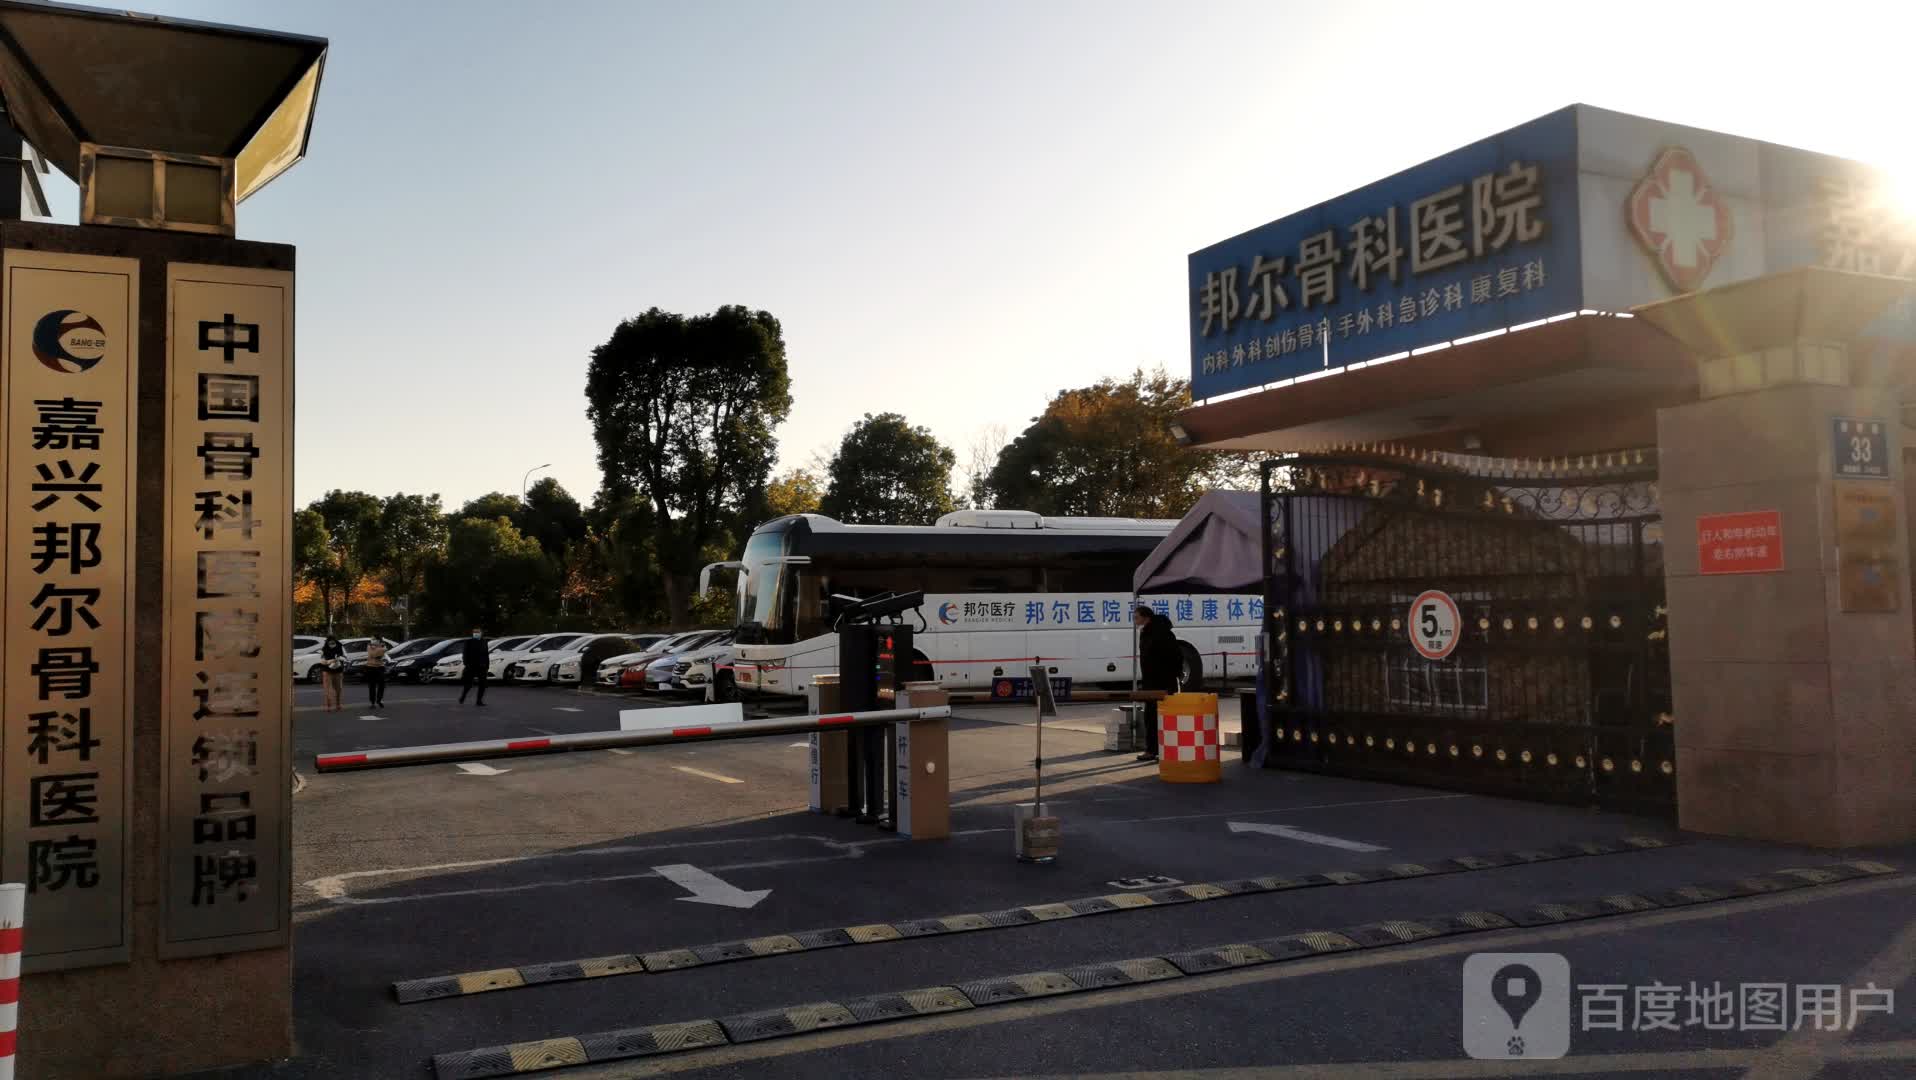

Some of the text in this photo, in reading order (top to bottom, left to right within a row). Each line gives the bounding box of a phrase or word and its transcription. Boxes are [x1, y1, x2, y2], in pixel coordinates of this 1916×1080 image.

[1199, 159, 1546, 337] 邦尔骨科医院
[1851, 436, 1873, 463] 33
[27, 397, 104, 894] 嘉兴邦尔骨科医院
[191, 313, 261, 906] 中国骨科医院连锁品牌
[963, 601, 1016, 617] 邦尔医疗
[1422, 605, 1438, 638] 5
